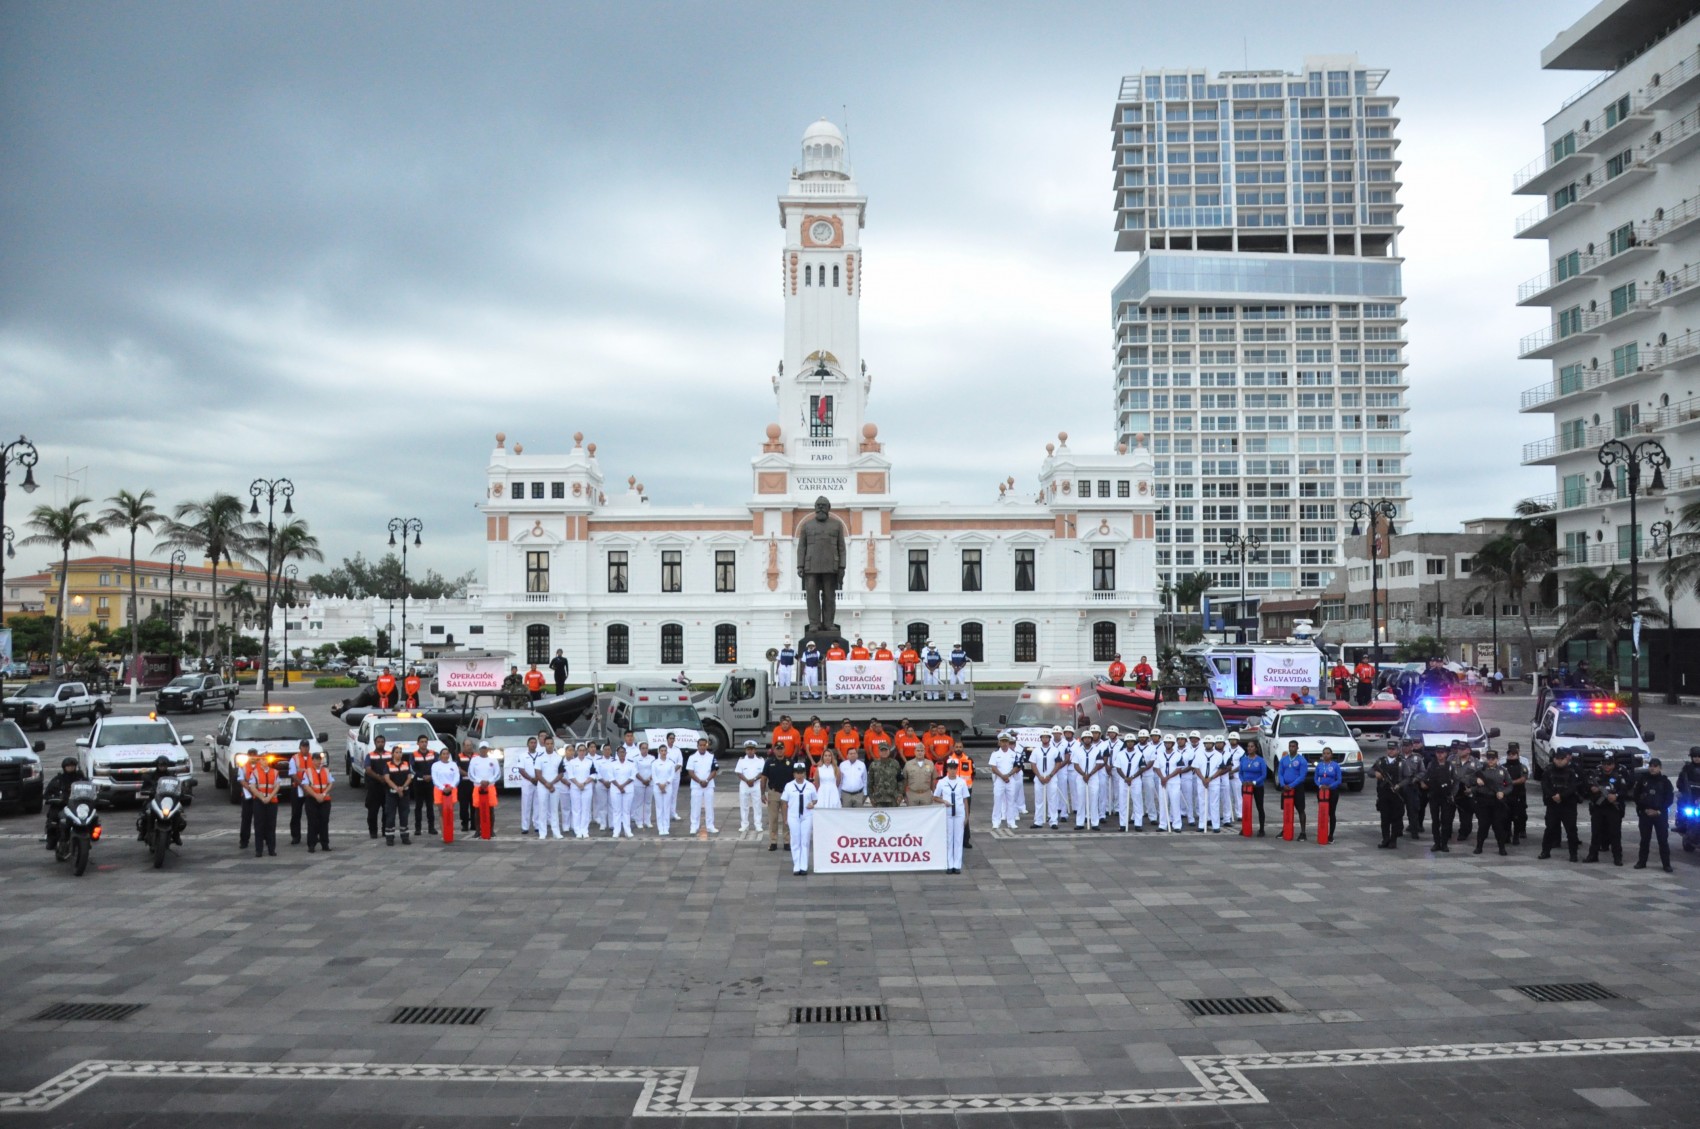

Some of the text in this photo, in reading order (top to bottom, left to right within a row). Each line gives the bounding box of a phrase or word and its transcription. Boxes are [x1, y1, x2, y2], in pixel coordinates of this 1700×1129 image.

[149, 663, 171, 672] PEME
[1266, 667, 1309, 675] OPERACIÓN
[450, 671, 494, 680] OPERACIÓN
[838, 674, 882, 682] OPERACIÓN
[1263, 675, 1312, 683] SALVAVIDAS
[446, 680, 497, 688] SALVAVIDAS
[835, 683, 886, 691] SALVAVIDAS
[836, 833, 923, 848] OPERACIÓN
[830, 850, 931, 864] SALVAVIDAS
